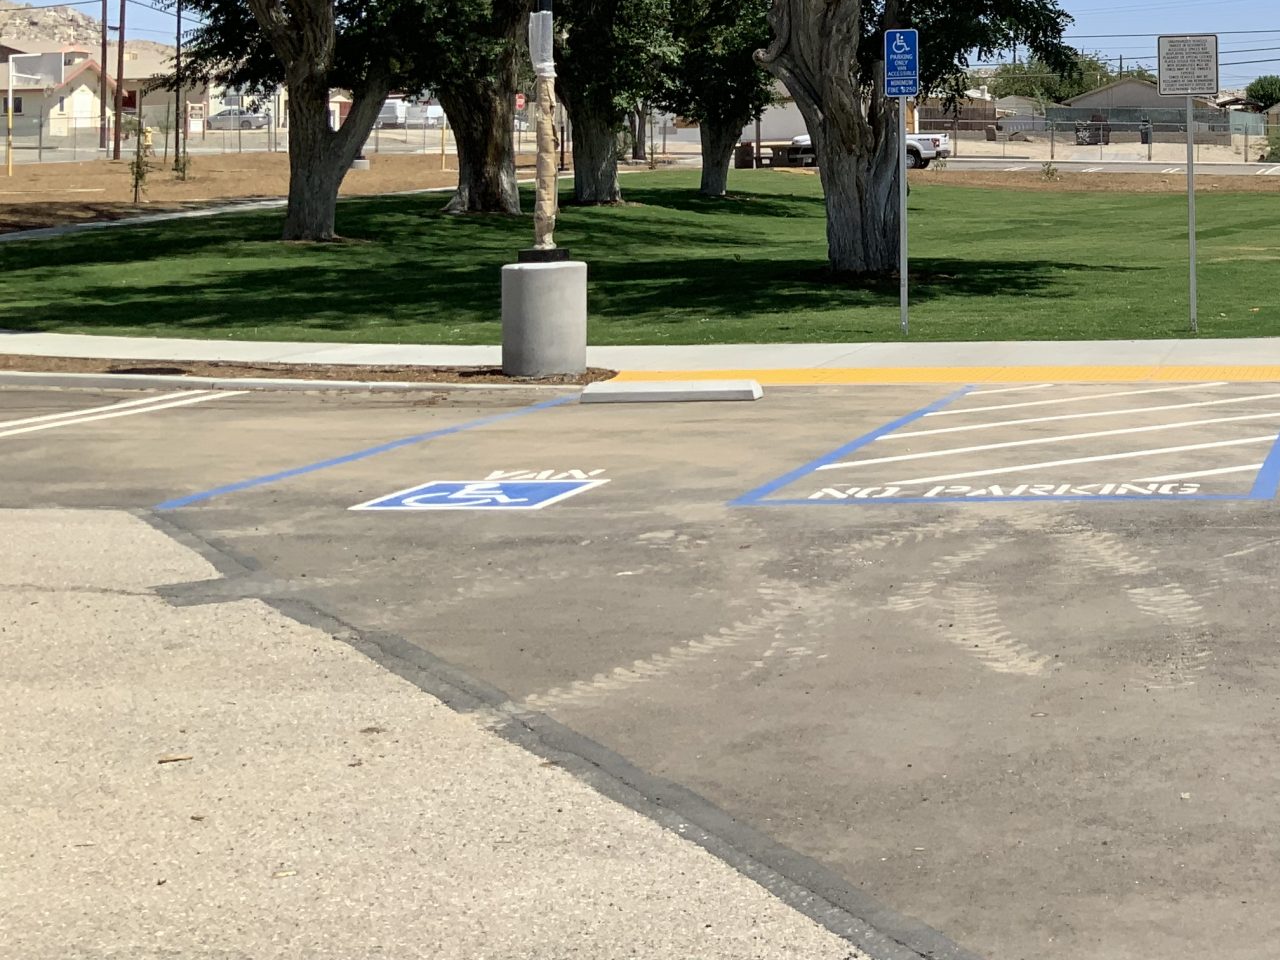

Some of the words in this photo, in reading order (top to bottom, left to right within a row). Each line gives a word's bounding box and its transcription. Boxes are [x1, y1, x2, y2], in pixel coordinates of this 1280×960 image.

[484, 469, 606, 480] VAN
[807, 485, 901, 499] NO
[923, 483, 1202, 497] PARKING
